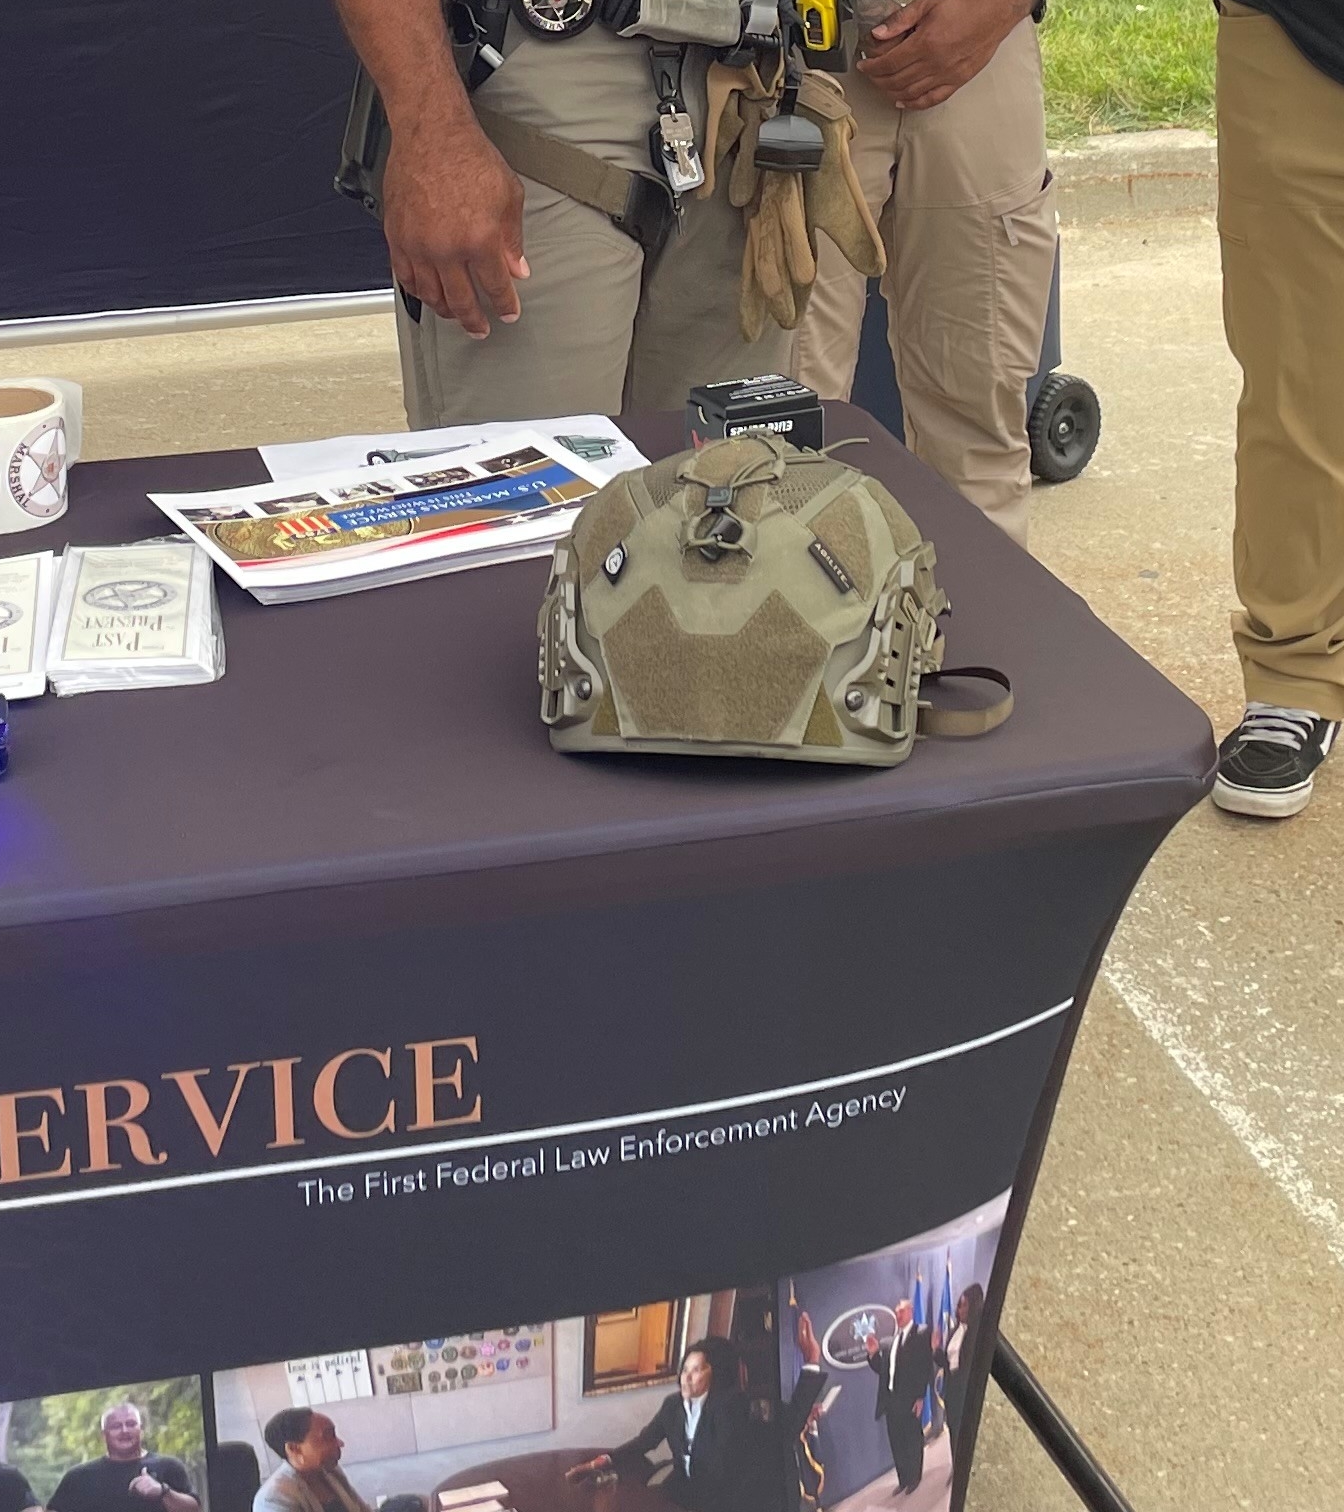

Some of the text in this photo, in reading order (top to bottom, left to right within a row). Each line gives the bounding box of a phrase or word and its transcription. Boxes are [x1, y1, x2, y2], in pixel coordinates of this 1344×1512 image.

[9, 442, 31, 508] MARSHAL
[347, 479, 547, 526] U.S. MARSHALS SERVICE
[81, 615, 163, 631] PRESENT
[91, 632, 140, 651] PAST
[298, 1085, 908, 1207] The First Federal Law Enforcement Agency
